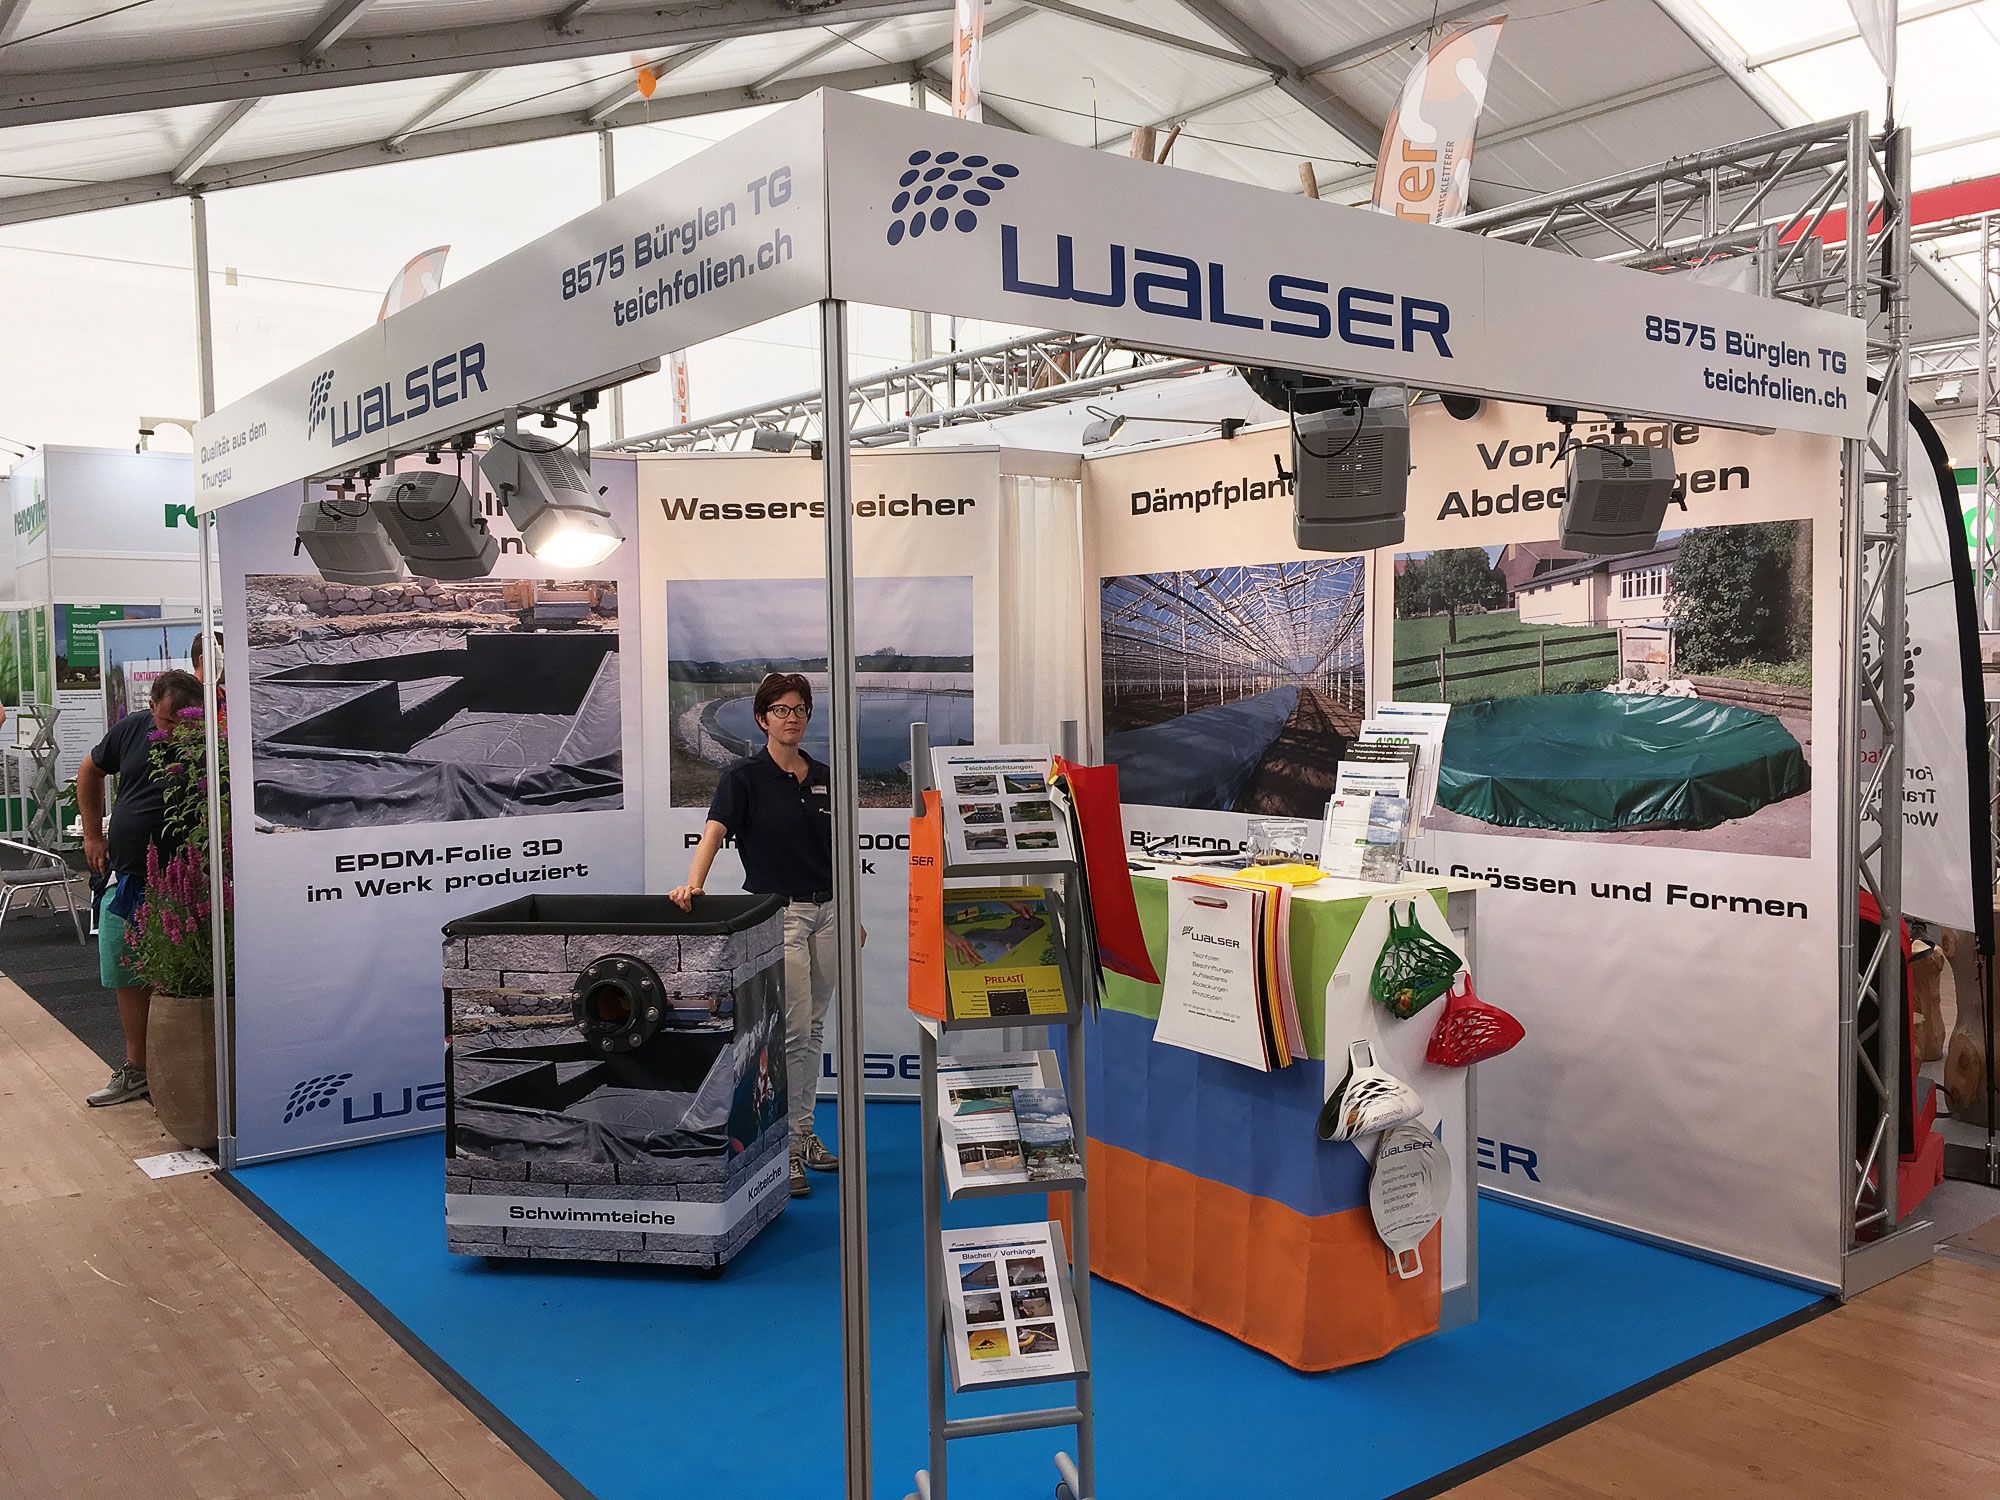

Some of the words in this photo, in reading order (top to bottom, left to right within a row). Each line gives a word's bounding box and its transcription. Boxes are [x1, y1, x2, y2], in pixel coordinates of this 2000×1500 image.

[561, 244, 625, 301] 8575
[635, 200, 737, 271] Bürglen
[747, 166, 792, 213] TG
[613, 228, 793, 327] teichfolien.ch
[1645, 315, 1716, 351] 8575
[1725, 331, 1810, 369] Bürglen
[1818, 347, 1848, 375] TG
[1703, 366, 1848, 410] teichfolien.ch
[201, 435, 230, 464] Qualität
[232, 431, 247, 450] aus
[249, 422, 267, 442] dem
[201, 466, 232, 491] Thurgau
[1131, 477, 1295, 517] Dämpfplan
[660, 493, 976, 521] Wasserseicher
[335, 844, 513, 873] EPDM-Folie
[522, 838, 563, 857] 3D
[307, 885, 342, 903] im
[355, 875, 433, 898] Werk
[445, 863, 589, 893] produziert
[1450, 864, 1576, 896] Grössen
[1591, 881, 1652, 904] und
[1666, 884, 1809, 920] Formen
[747, 1165, 783, 1202] Koiteiche
[509, 1204, 676, 1226] Schwimmteiche
[962, 1252, 992, 1260] Blachen
[1000, 1248, 1036, 1257] Vorhänge
